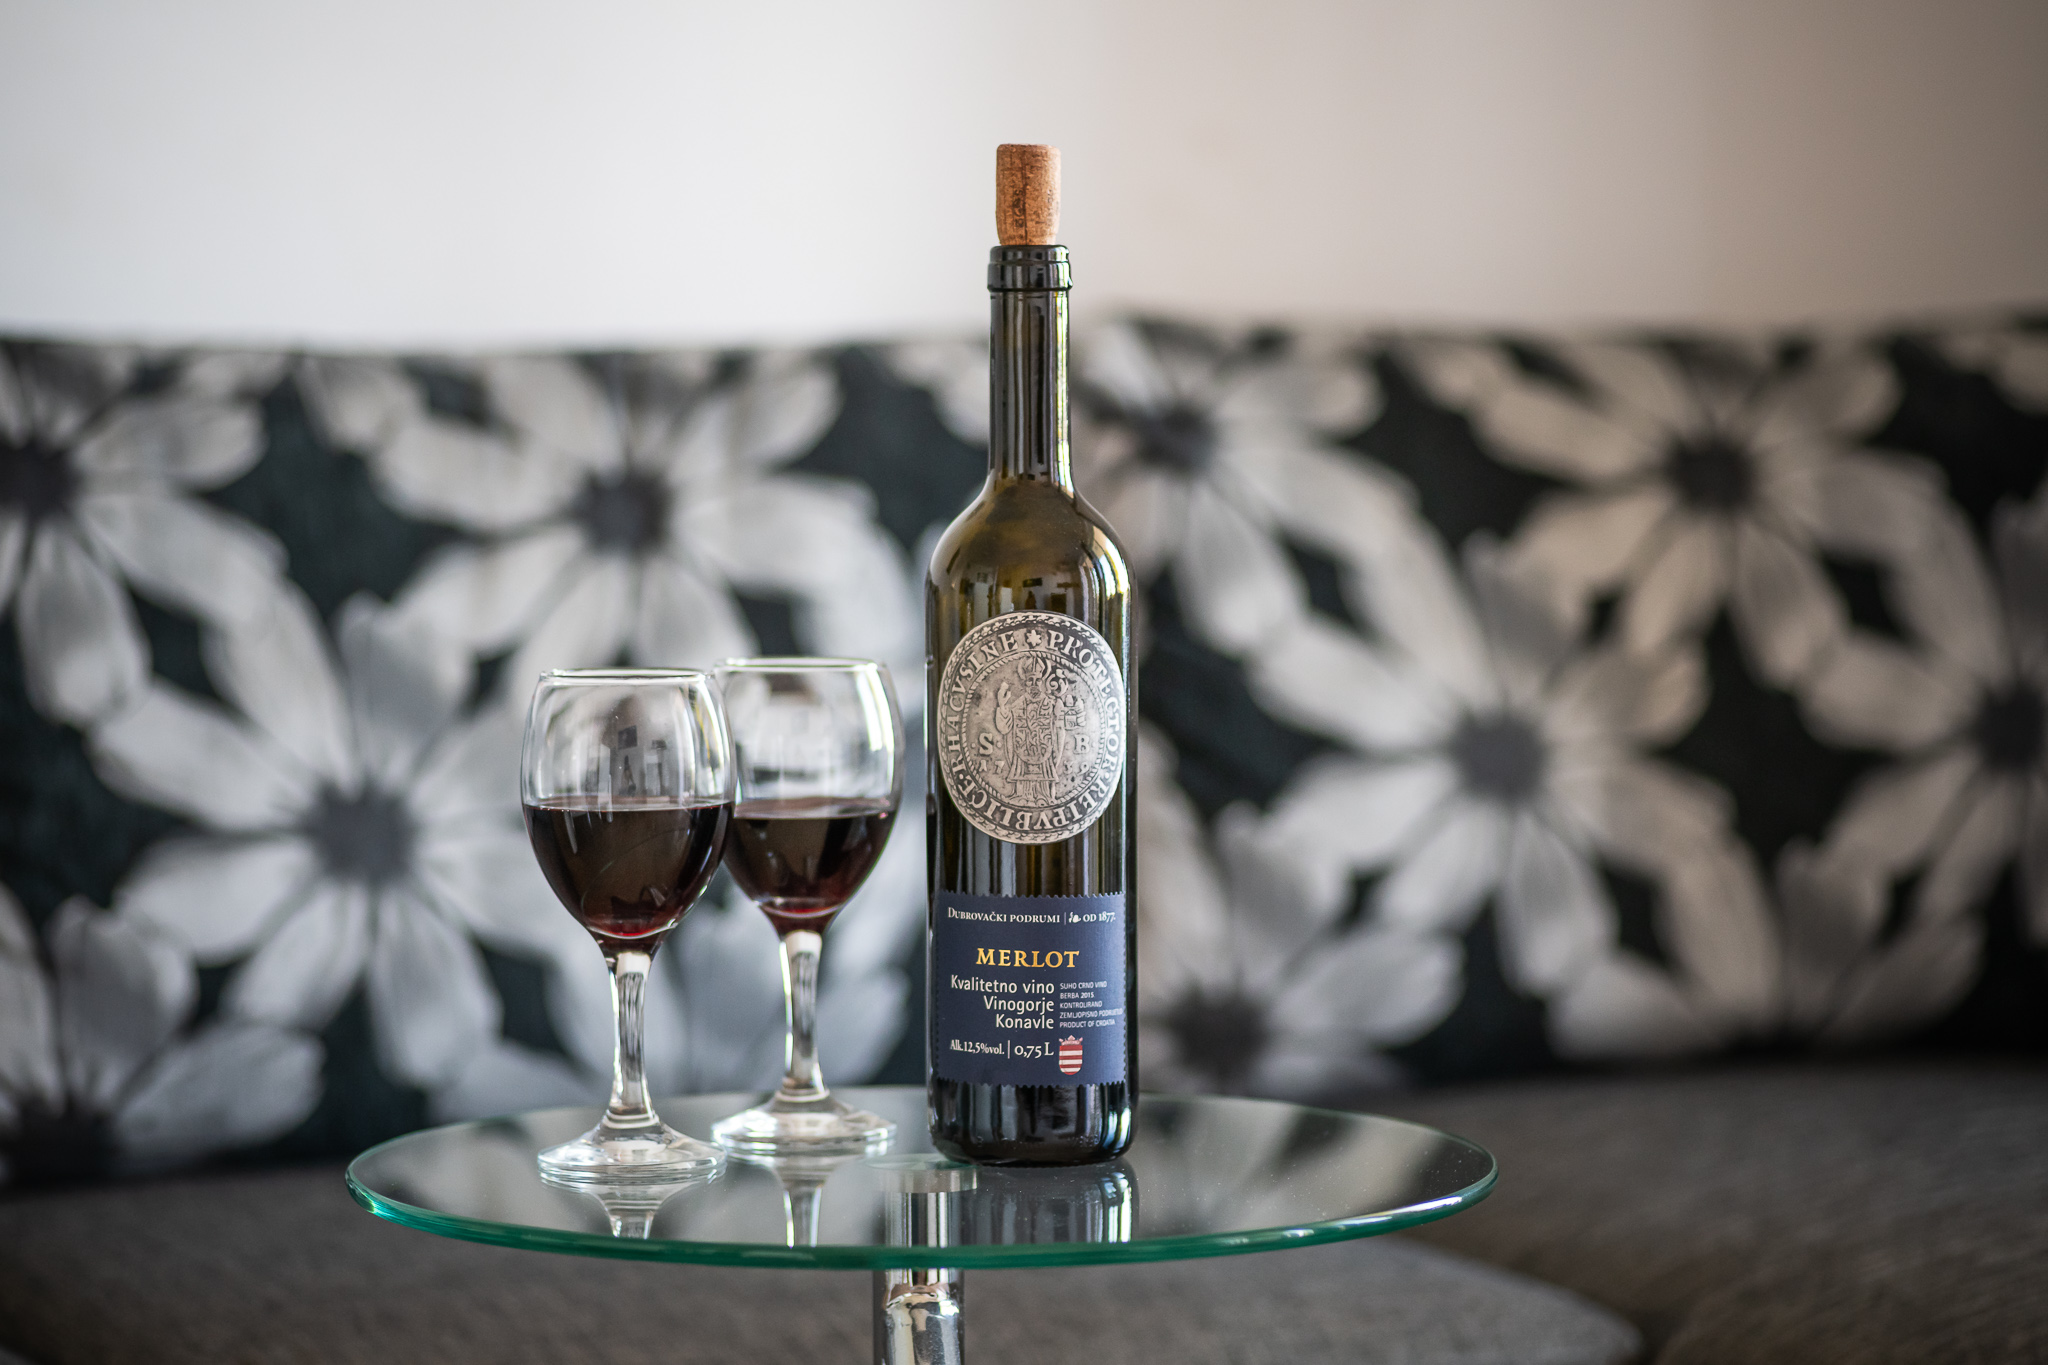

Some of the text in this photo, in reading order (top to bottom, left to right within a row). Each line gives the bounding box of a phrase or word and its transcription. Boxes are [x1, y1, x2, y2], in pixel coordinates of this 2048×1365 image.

[1010, 914, 1060, 923] PODRUMI
[1083, 913, 1097, 922] OD
[976, 947, 1080, 968] MERLOT
[951, 974, 1055, 994] Kvalitetno vino
[1060, 982, 1077, 990] SUHO
[983, 995, 1055, 1015] Vinogorje
[995, 1013, 1055, 1029] Konavle
[1060, 1020, 1087, 1028] PRODUCT
[1087, 1020, 1095, 1028] OF
[1014, 1045, 1042, 1059] 0,75
